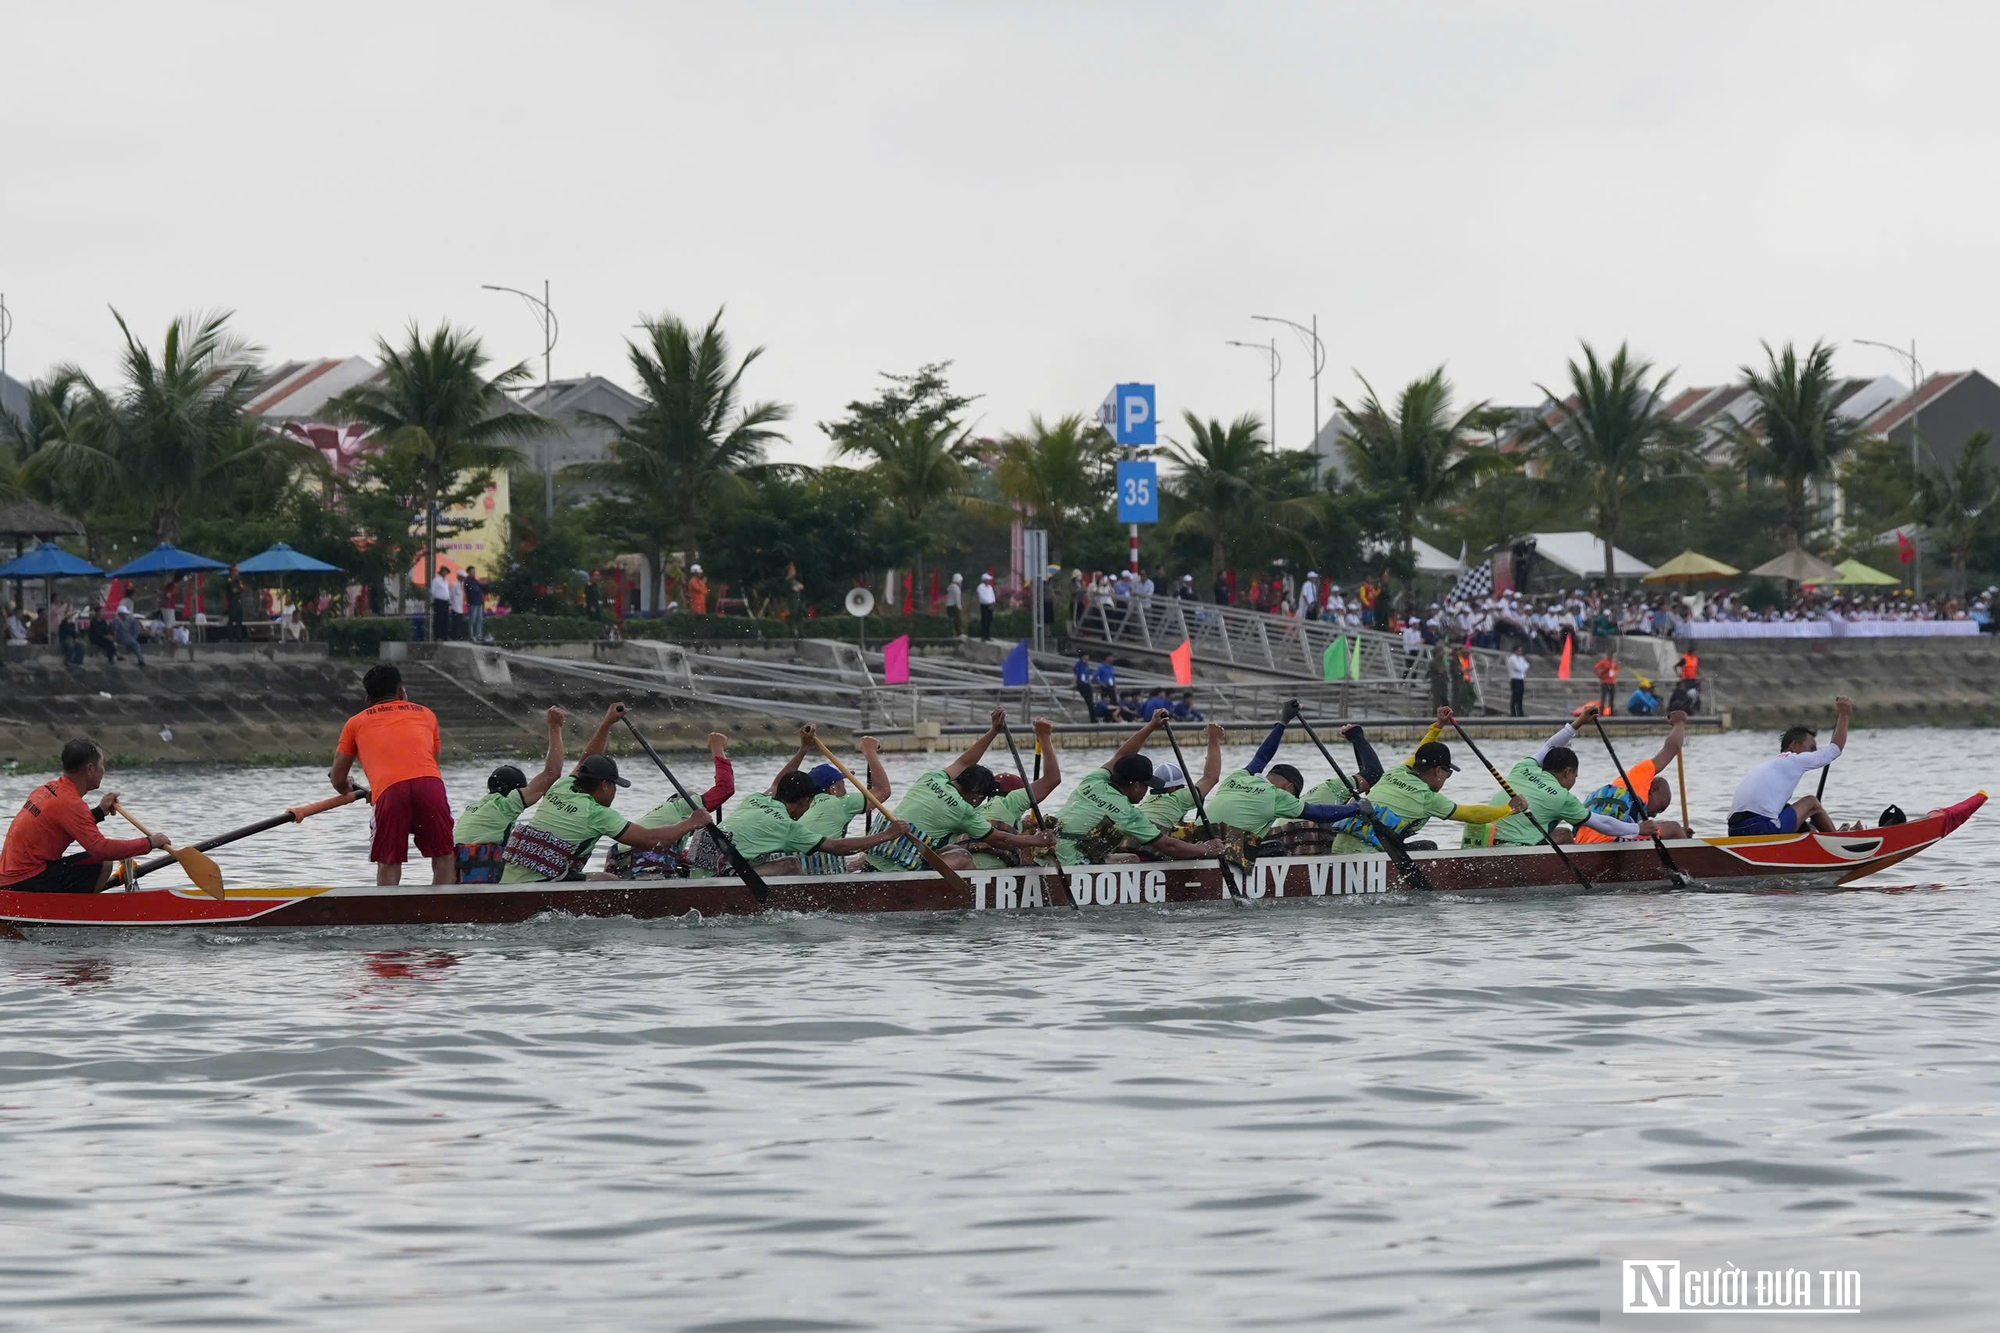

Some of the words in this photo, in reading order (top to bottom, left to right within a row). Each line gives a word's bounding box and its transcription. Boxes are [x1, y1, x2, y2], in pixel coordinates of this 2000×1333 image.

[1125, 396, 1149, 433] P
[1125, 478, 1150, 506] 35
[1545, 787, 1558, 796] NP
[944, 795, 959, 808] NP
[564, 804, 578, 815] NP
[1105, 803, 1120, 814] NP
[970, 875, 1043, 910] TRA
[1308, 862, 1387, 895] VINH
